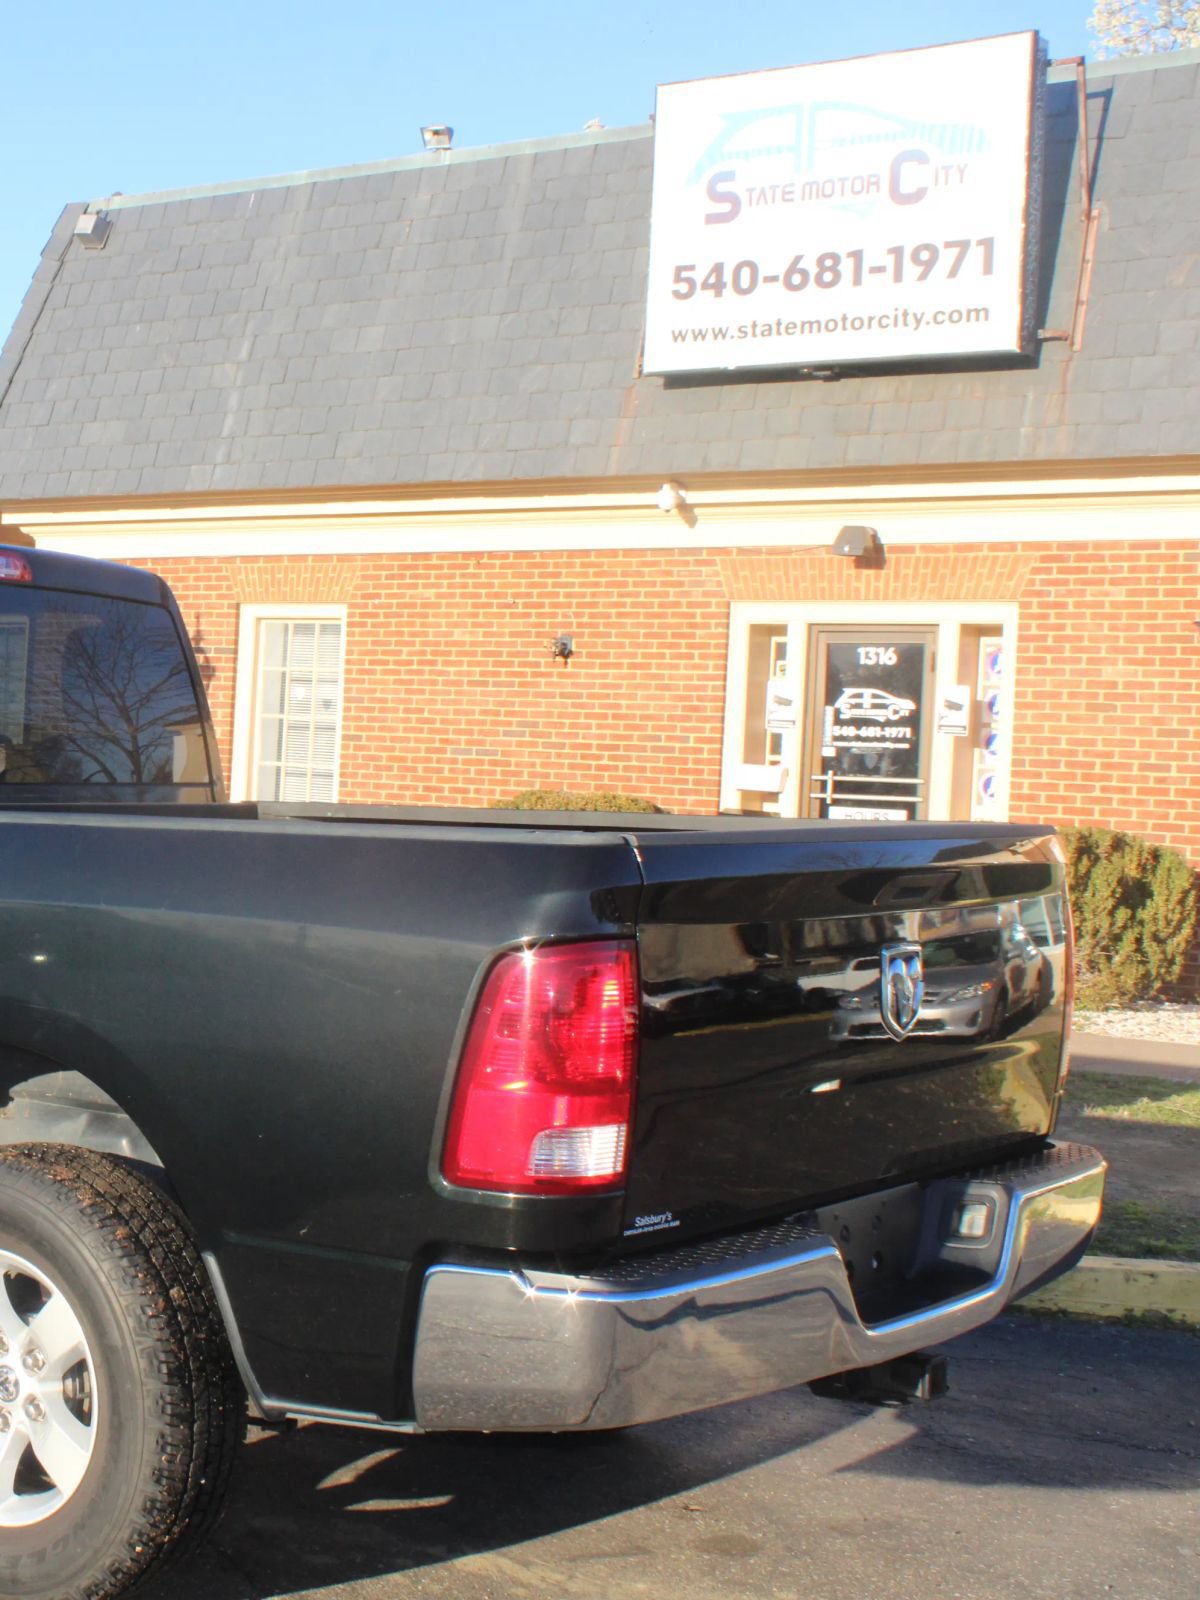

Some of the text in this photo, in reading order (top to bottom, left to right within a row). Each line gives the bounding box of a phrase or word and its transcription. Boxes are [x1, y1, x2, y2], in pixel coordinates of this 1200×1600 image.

[704, 149, 968, 225] STATE MOTOR CITY
[671, 236, 996, 301] 540-681-1971
[671, 305, 990, 343] www.statemotorcity.com
[857, 646, 898, 665] 1316
